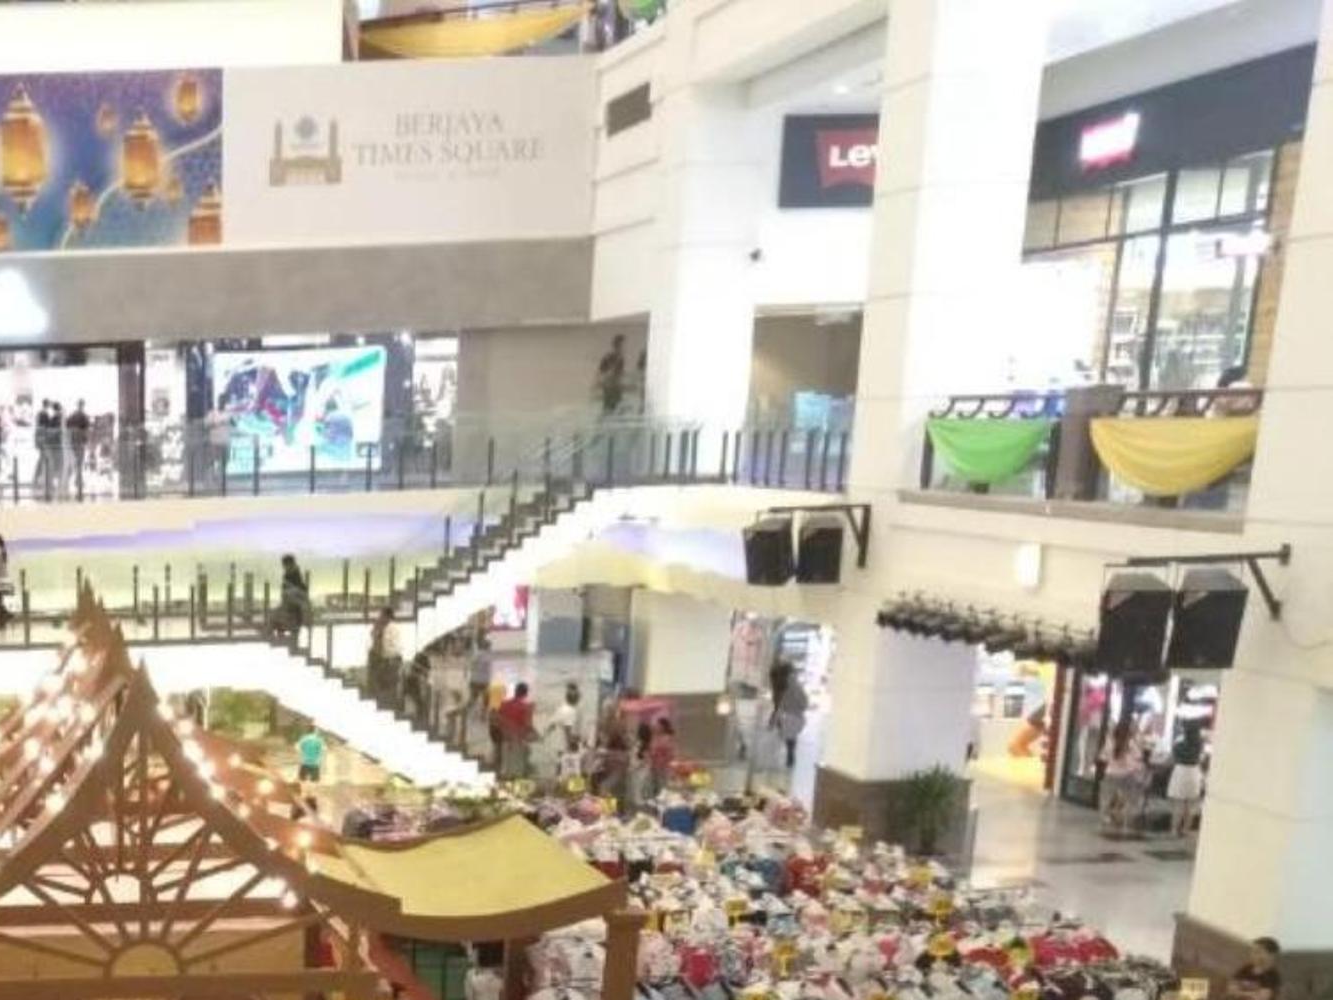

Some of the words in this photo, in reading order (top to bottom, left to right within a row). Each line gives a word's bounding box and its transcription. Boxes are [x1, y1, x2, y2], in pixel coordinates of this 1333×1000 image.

[394, 111, 504, 138] BERJAYA
[352, 141, 434, 167] TIMES
[440, 136, 545, 165] SQUARE
